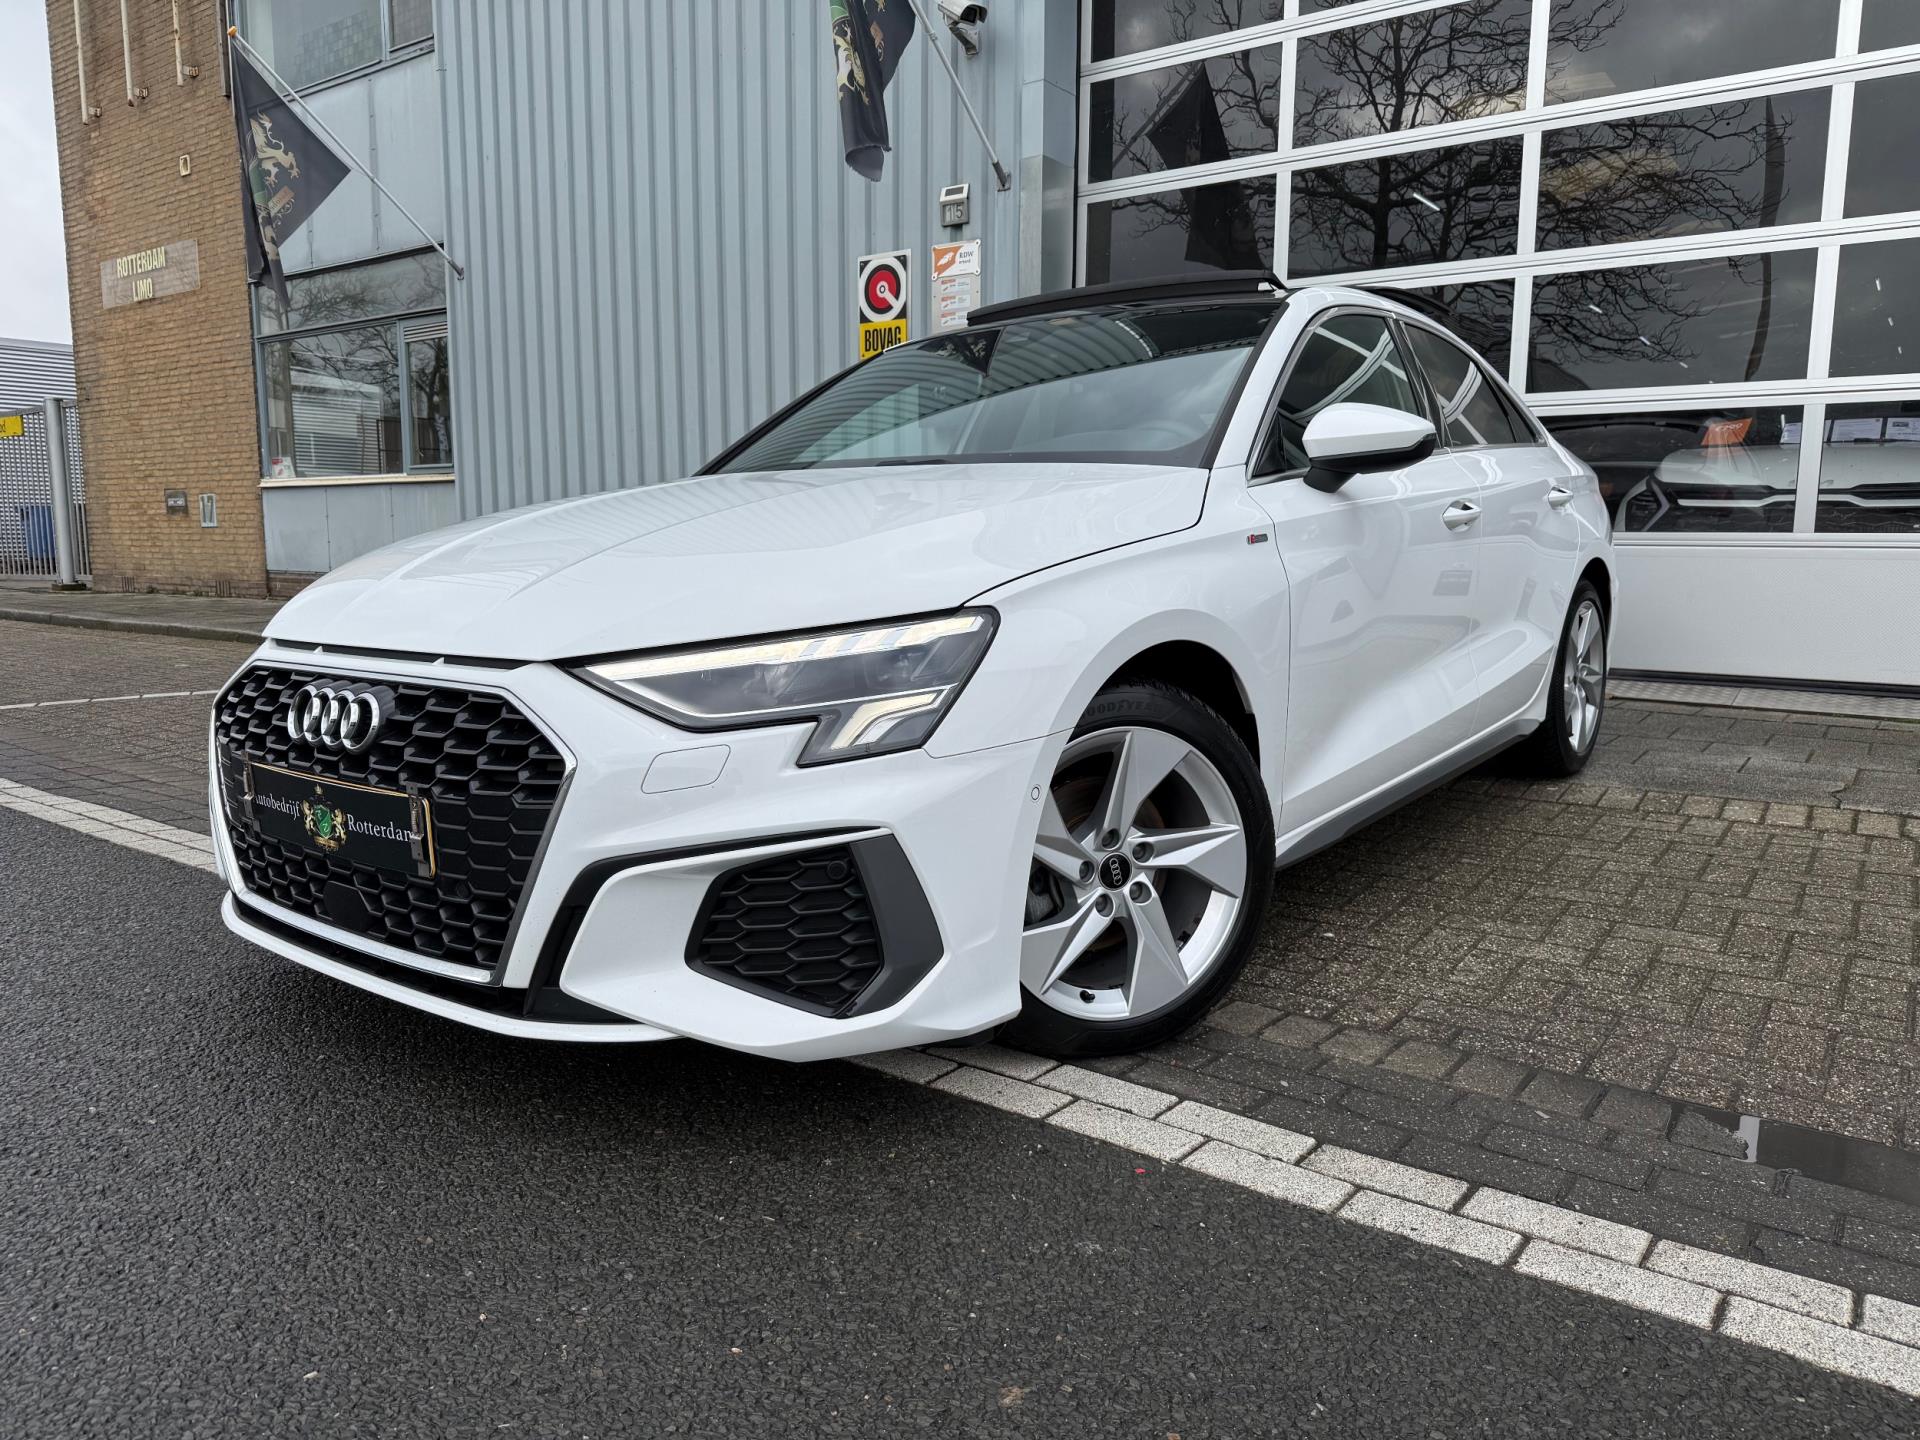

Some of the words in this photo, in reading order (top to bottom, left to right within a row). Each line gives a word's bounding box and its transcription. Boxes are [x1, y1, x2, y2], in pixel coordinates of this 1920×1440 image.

[116, 246, 166, 279] ROTTERDAM
[959, 250, 974, 259] RDW
[132, 277, 153, 302] LIMO
[864, 325, 902, 352] BOVAG
[255, 792, 301, 821] utobedrijf
